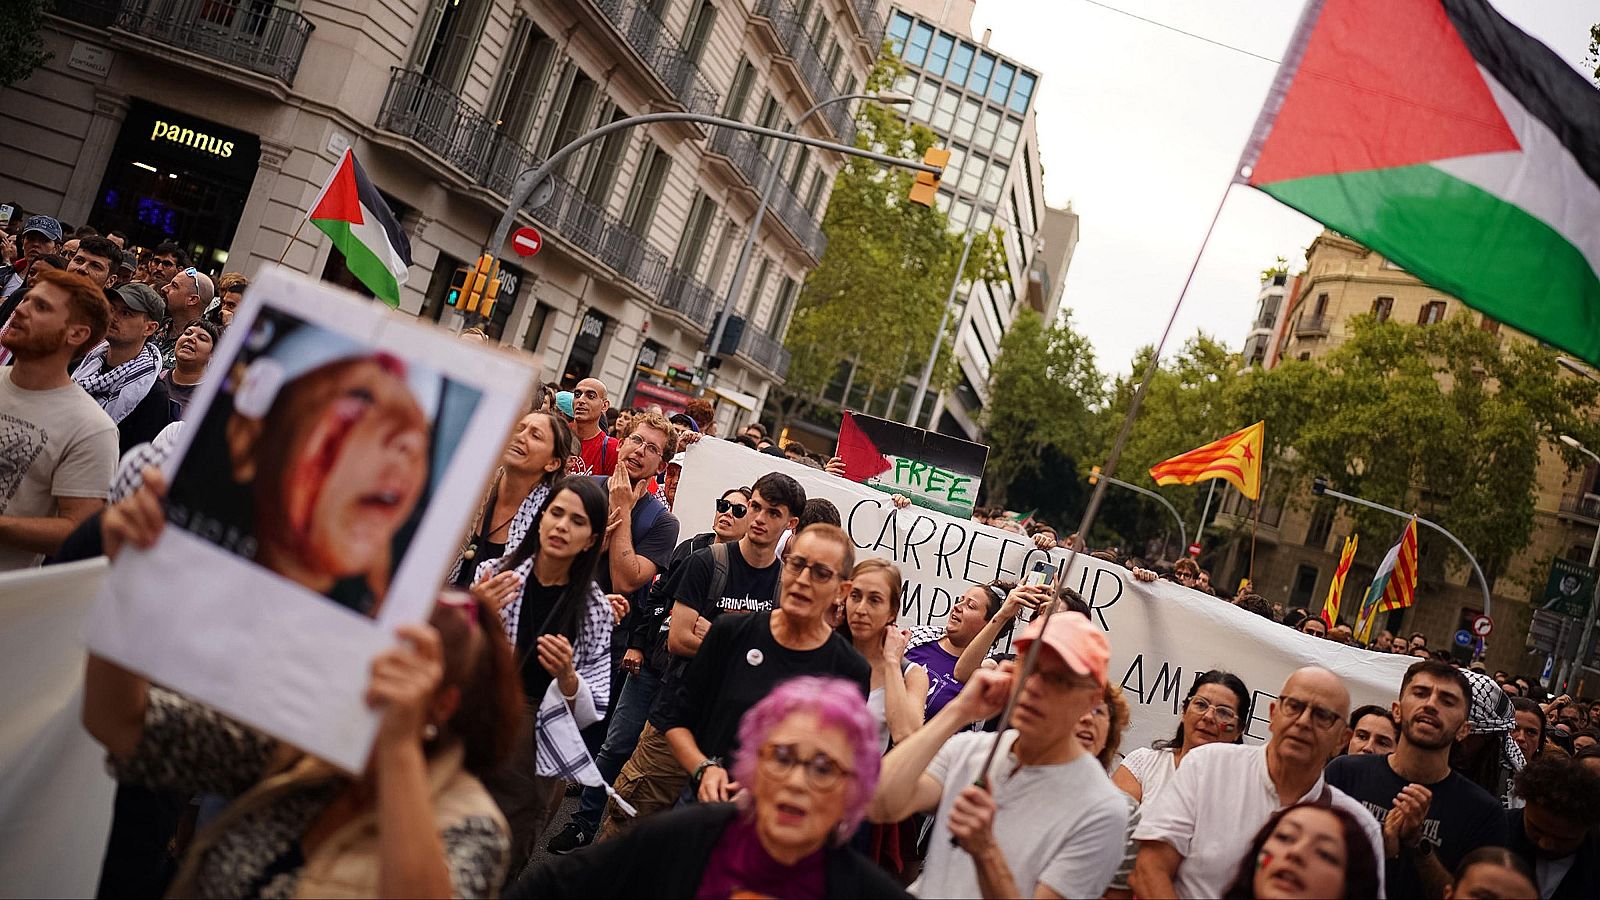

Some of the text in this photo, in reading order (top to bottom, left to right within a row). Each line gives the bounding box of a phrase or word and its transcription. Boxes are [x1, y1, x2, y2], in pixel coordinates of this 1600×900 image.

[151, 120, 235, 158] pannus
[496, 269, 517, 295] ans
[580, 315, 603, 338] pans
[895, 458, 973, 506] FREE
